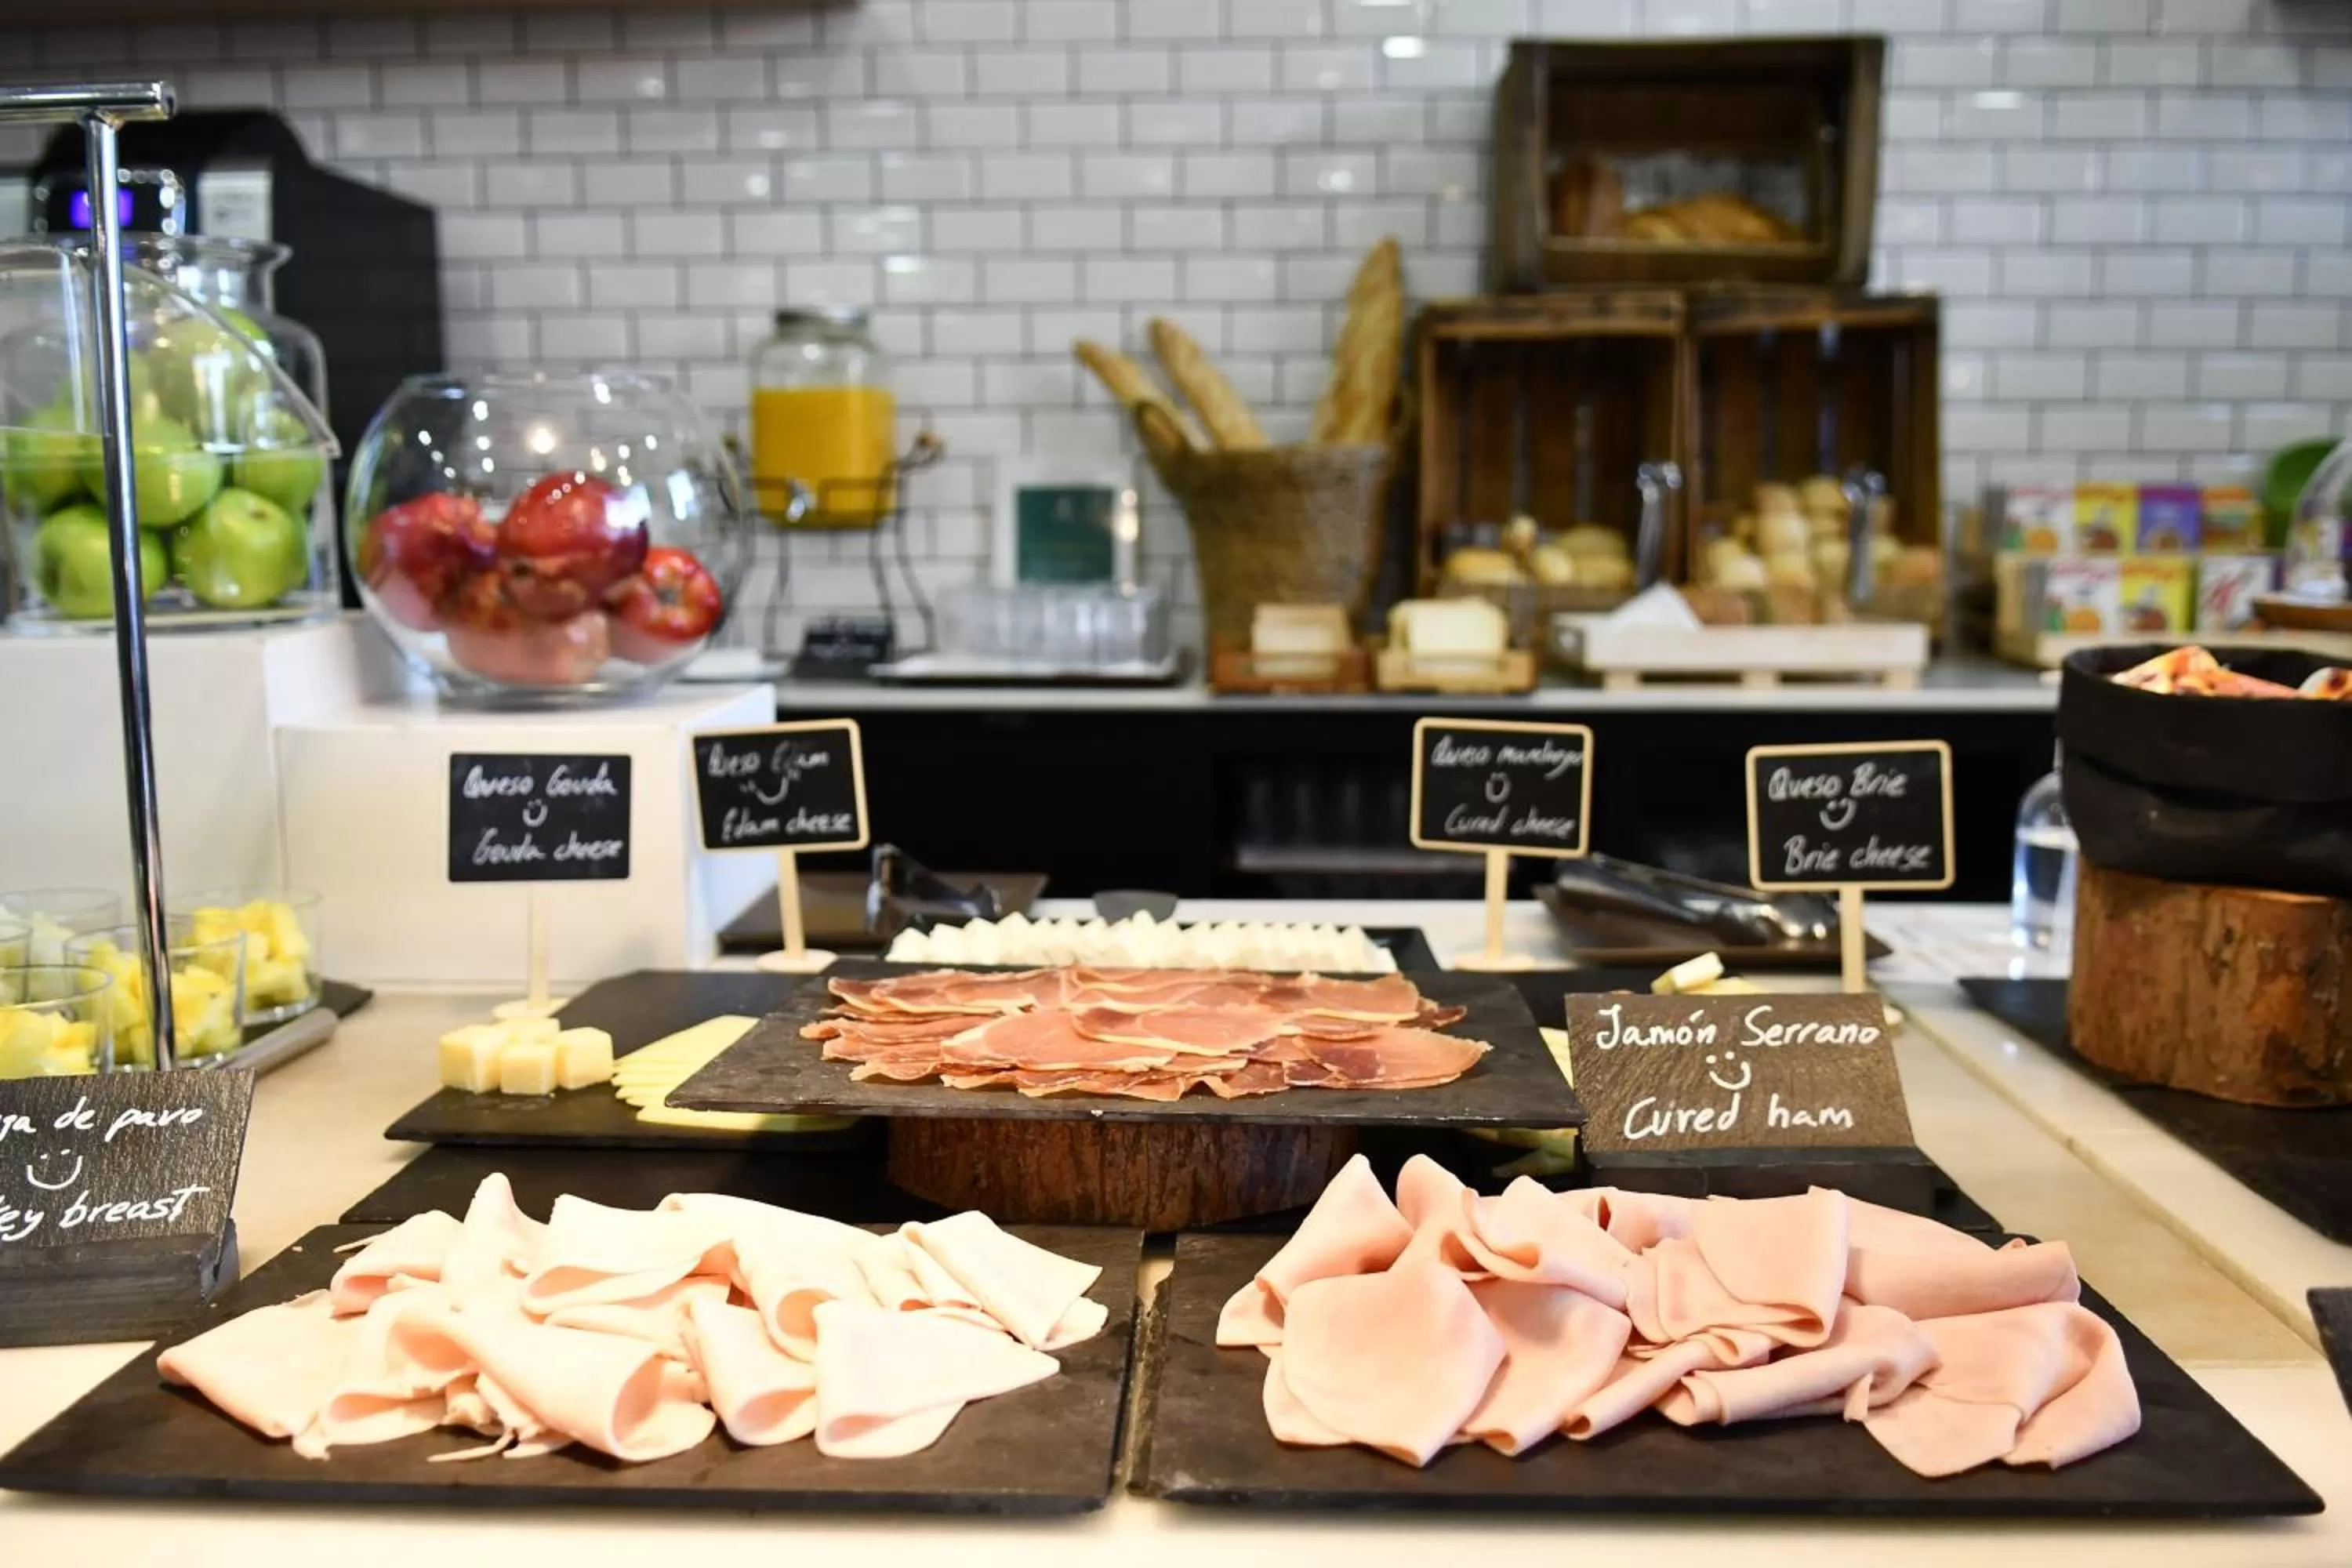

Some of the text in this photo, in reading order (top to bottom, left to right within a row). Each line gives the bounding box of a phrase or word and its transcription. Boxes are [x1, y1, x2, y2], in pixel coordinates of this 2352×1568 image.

[463, 764, 533, 798] Queso
[1768, 761, 1907, 801] Queso Brie
[1444, 803, 1509, 836] Cured
[1784, 834, 1932, 876] Brie cheese
[1596, 1004, 1880, 1049] Jamón Serrano
[0, 1095, 203, 1142] ga de pavo
[1624, 1092, 1854, 1139] Cured ham
[59, 1184, 210, 1229] breast
